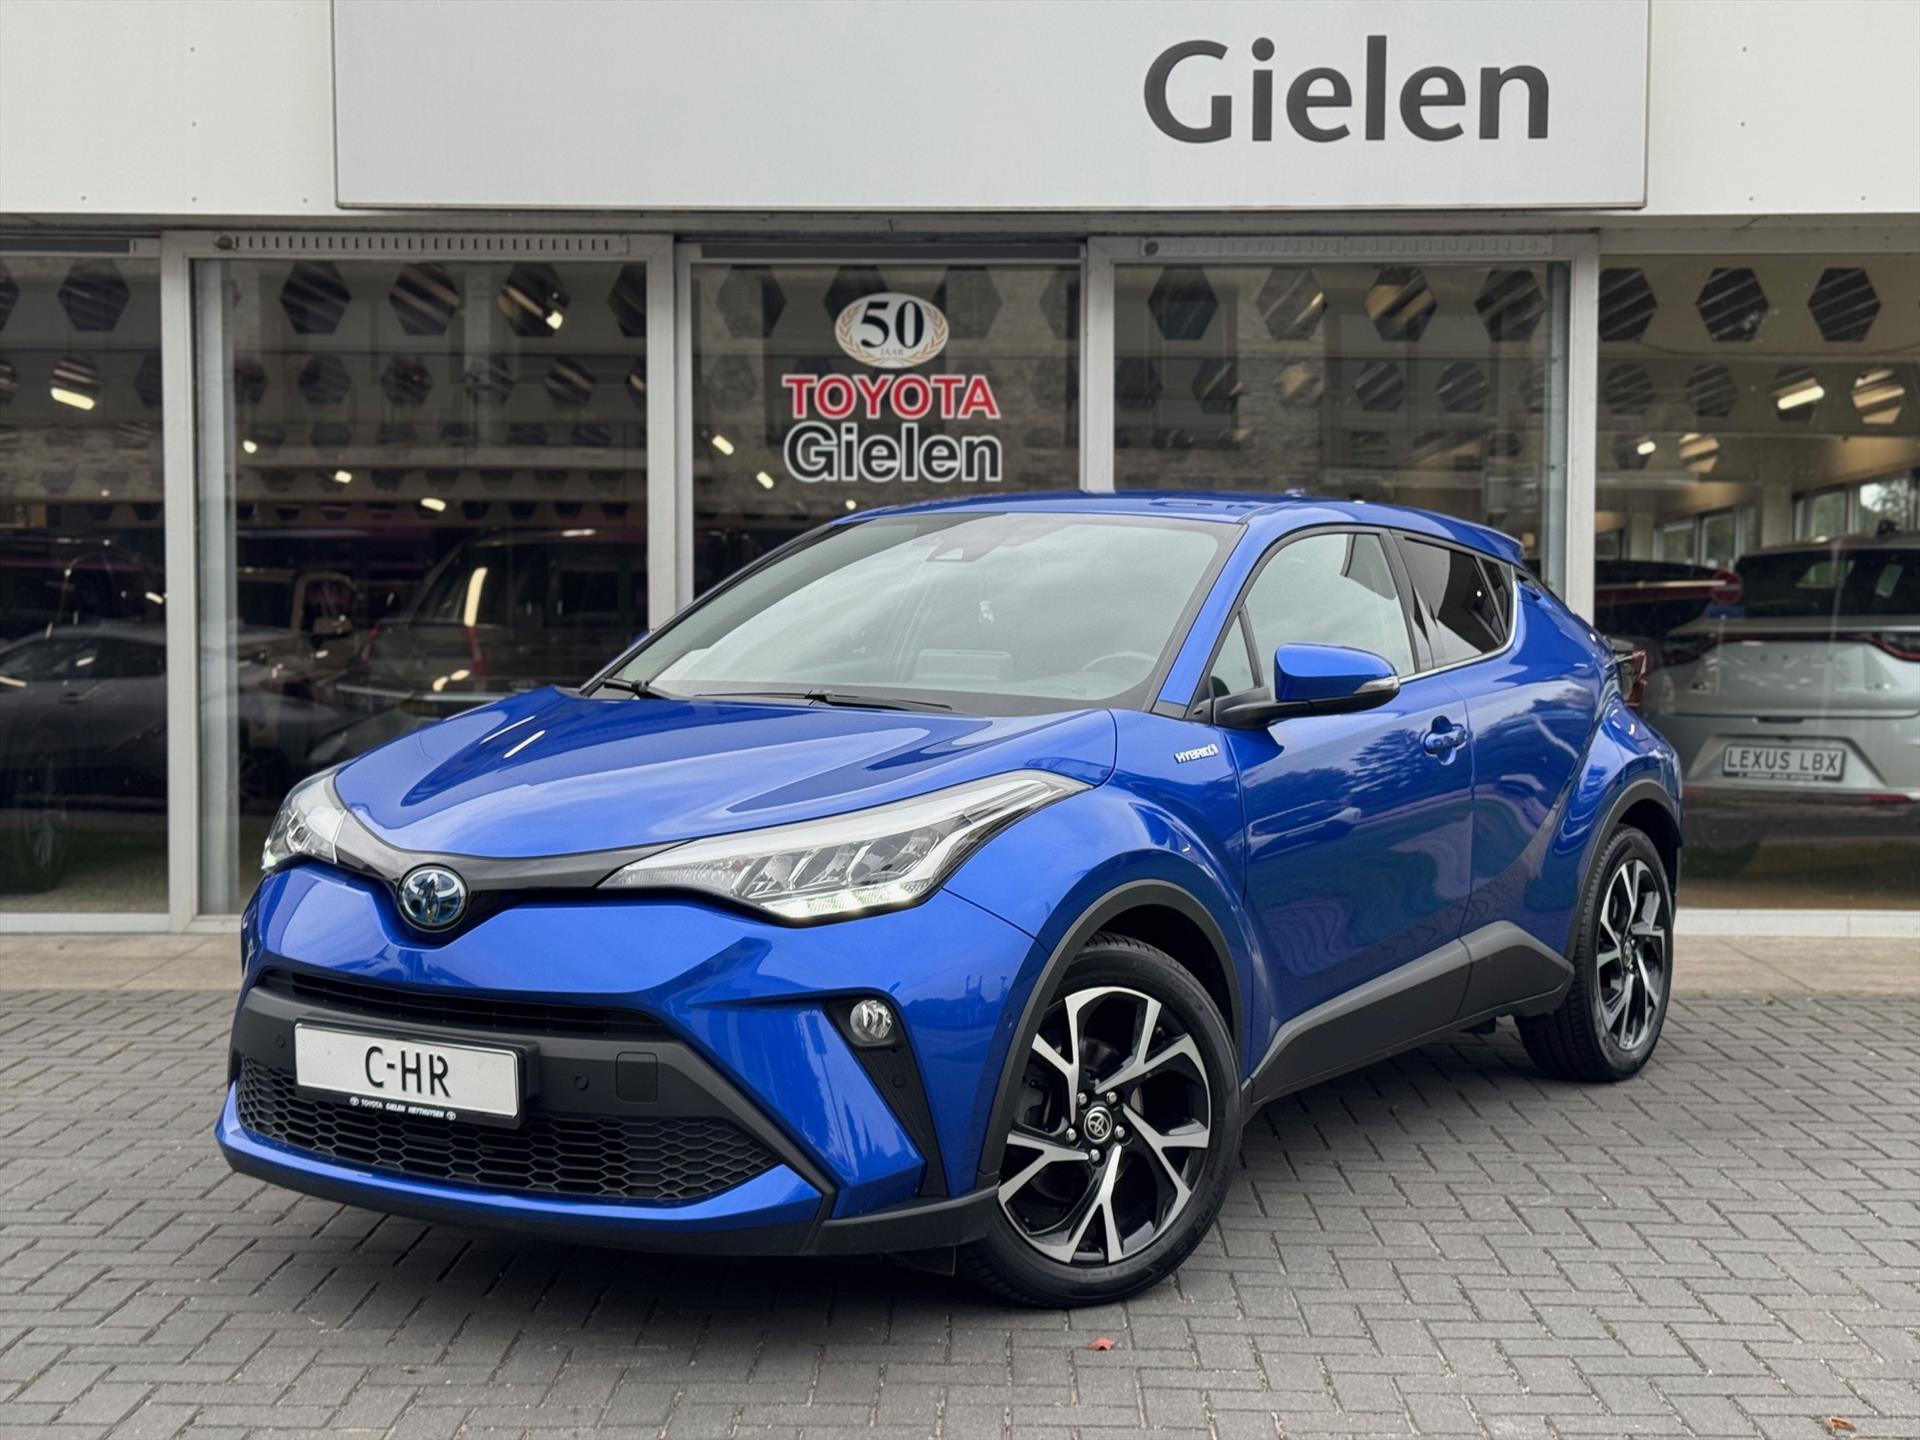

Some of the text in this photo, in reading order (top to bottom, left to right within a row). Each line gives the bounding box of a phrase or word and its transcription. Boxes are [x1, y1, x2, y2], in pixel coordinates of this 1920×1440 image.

[1144, 35, 1549, 143] Gielen
[860, 301, 925, 349] 50
[782, 375, 1001, 419] TOYOTA
[784, 421, 1002, 482] Gielen
[1174, 746, 1212, 763] HYBRID
[1727, 750, 1839, 772] LEXUS LBX
[365, 1046, 451, 1098] C-HR
[361, 1099, 383, 1109] TOYOTA
